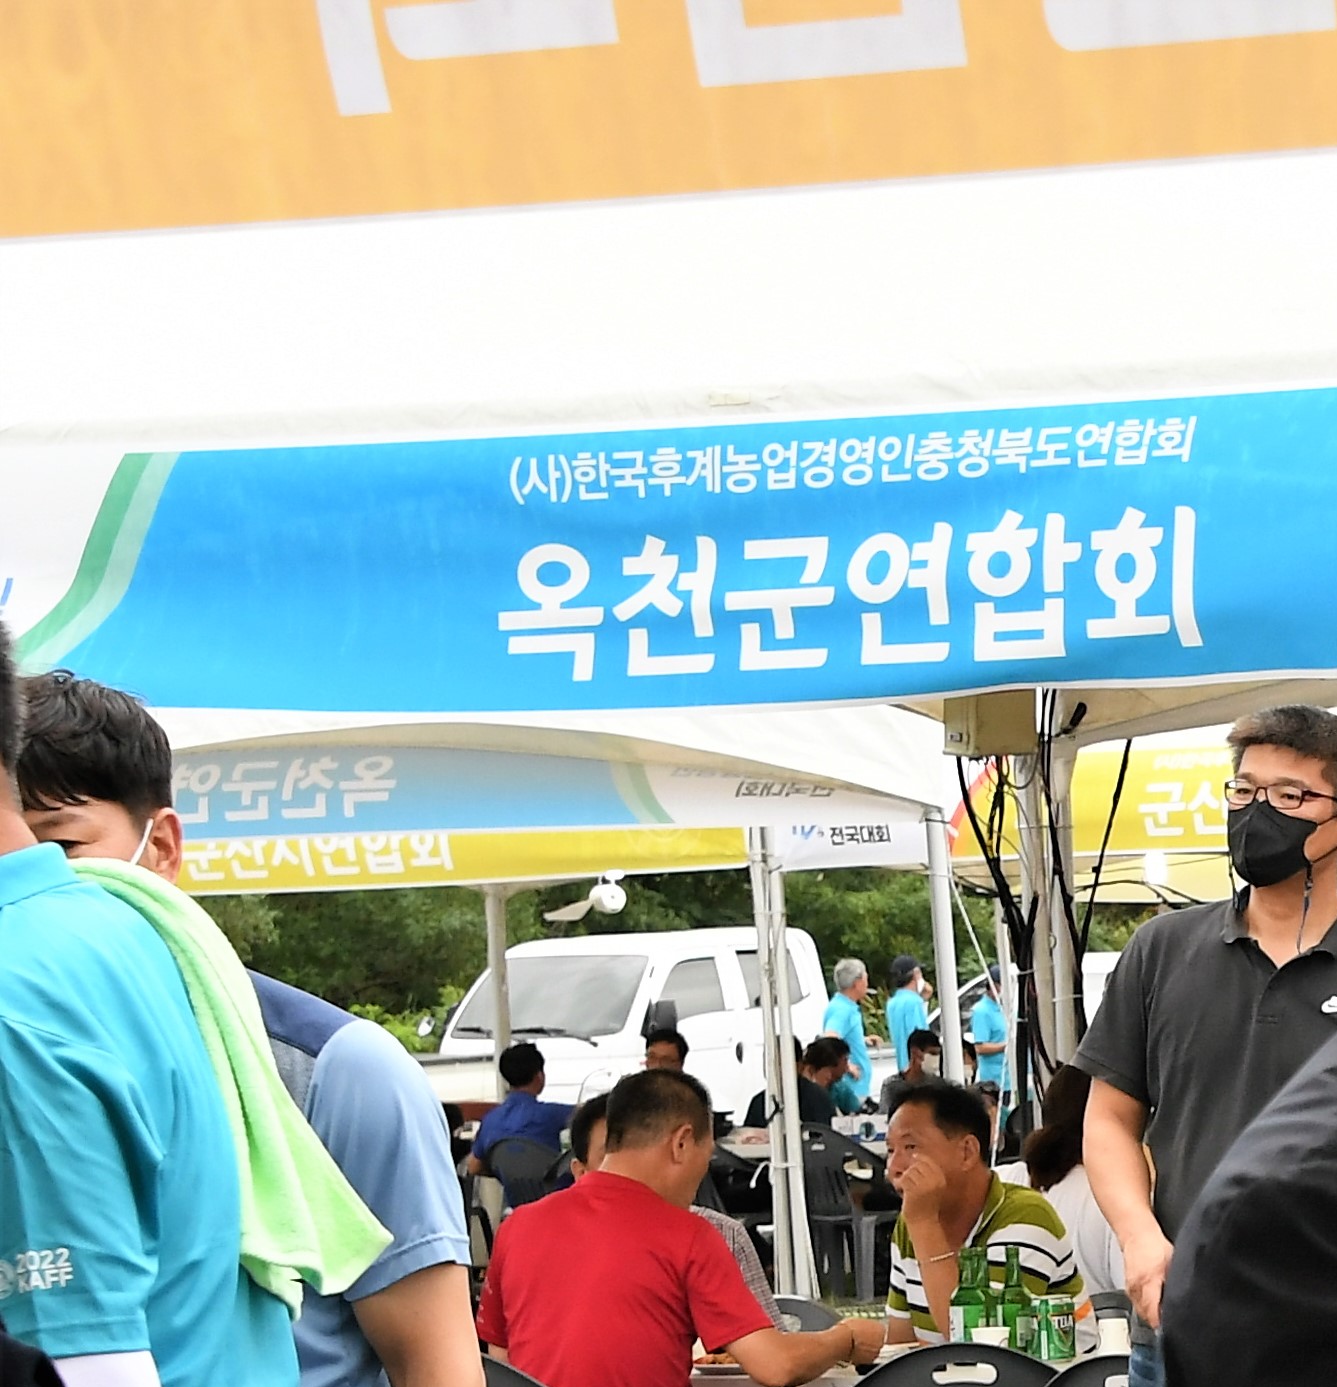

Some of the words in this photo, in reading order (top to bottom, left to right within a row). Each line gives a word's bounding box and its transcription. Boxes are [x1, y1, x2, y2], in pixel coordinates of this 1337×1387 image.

[509, 415, 1197, 504] (사)한국후계농업경영인충청북도연합회
[498, 505, 1204, 682] 옥천군연합회
[829, 824, 892, 846] 전국대회
[16, 1247, 71, 1274] 2022
[18, 1267, 74, 1293] KAFF
